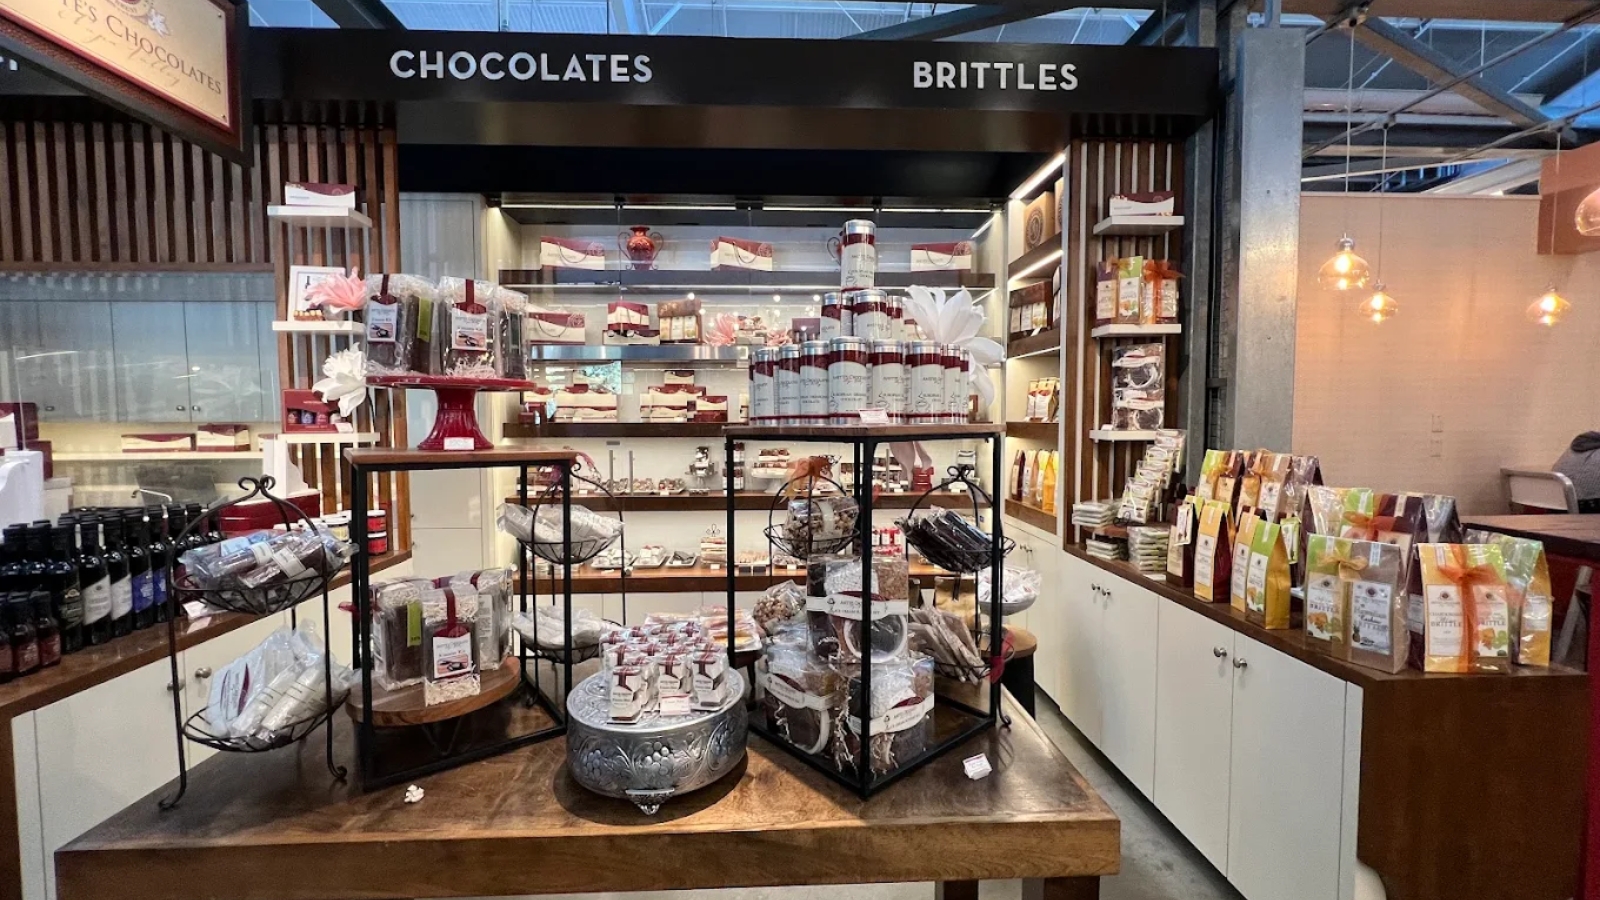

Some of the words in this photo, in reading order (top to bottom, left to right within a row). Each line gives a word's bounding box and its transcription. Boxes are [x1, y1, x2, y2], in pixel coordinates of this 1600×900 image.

[106, 15, 222, 95] CHOCOLATES
[390, 50, 652, 83] CHOCOLATES
[913, 61, 1078, 91] BRITTLES
